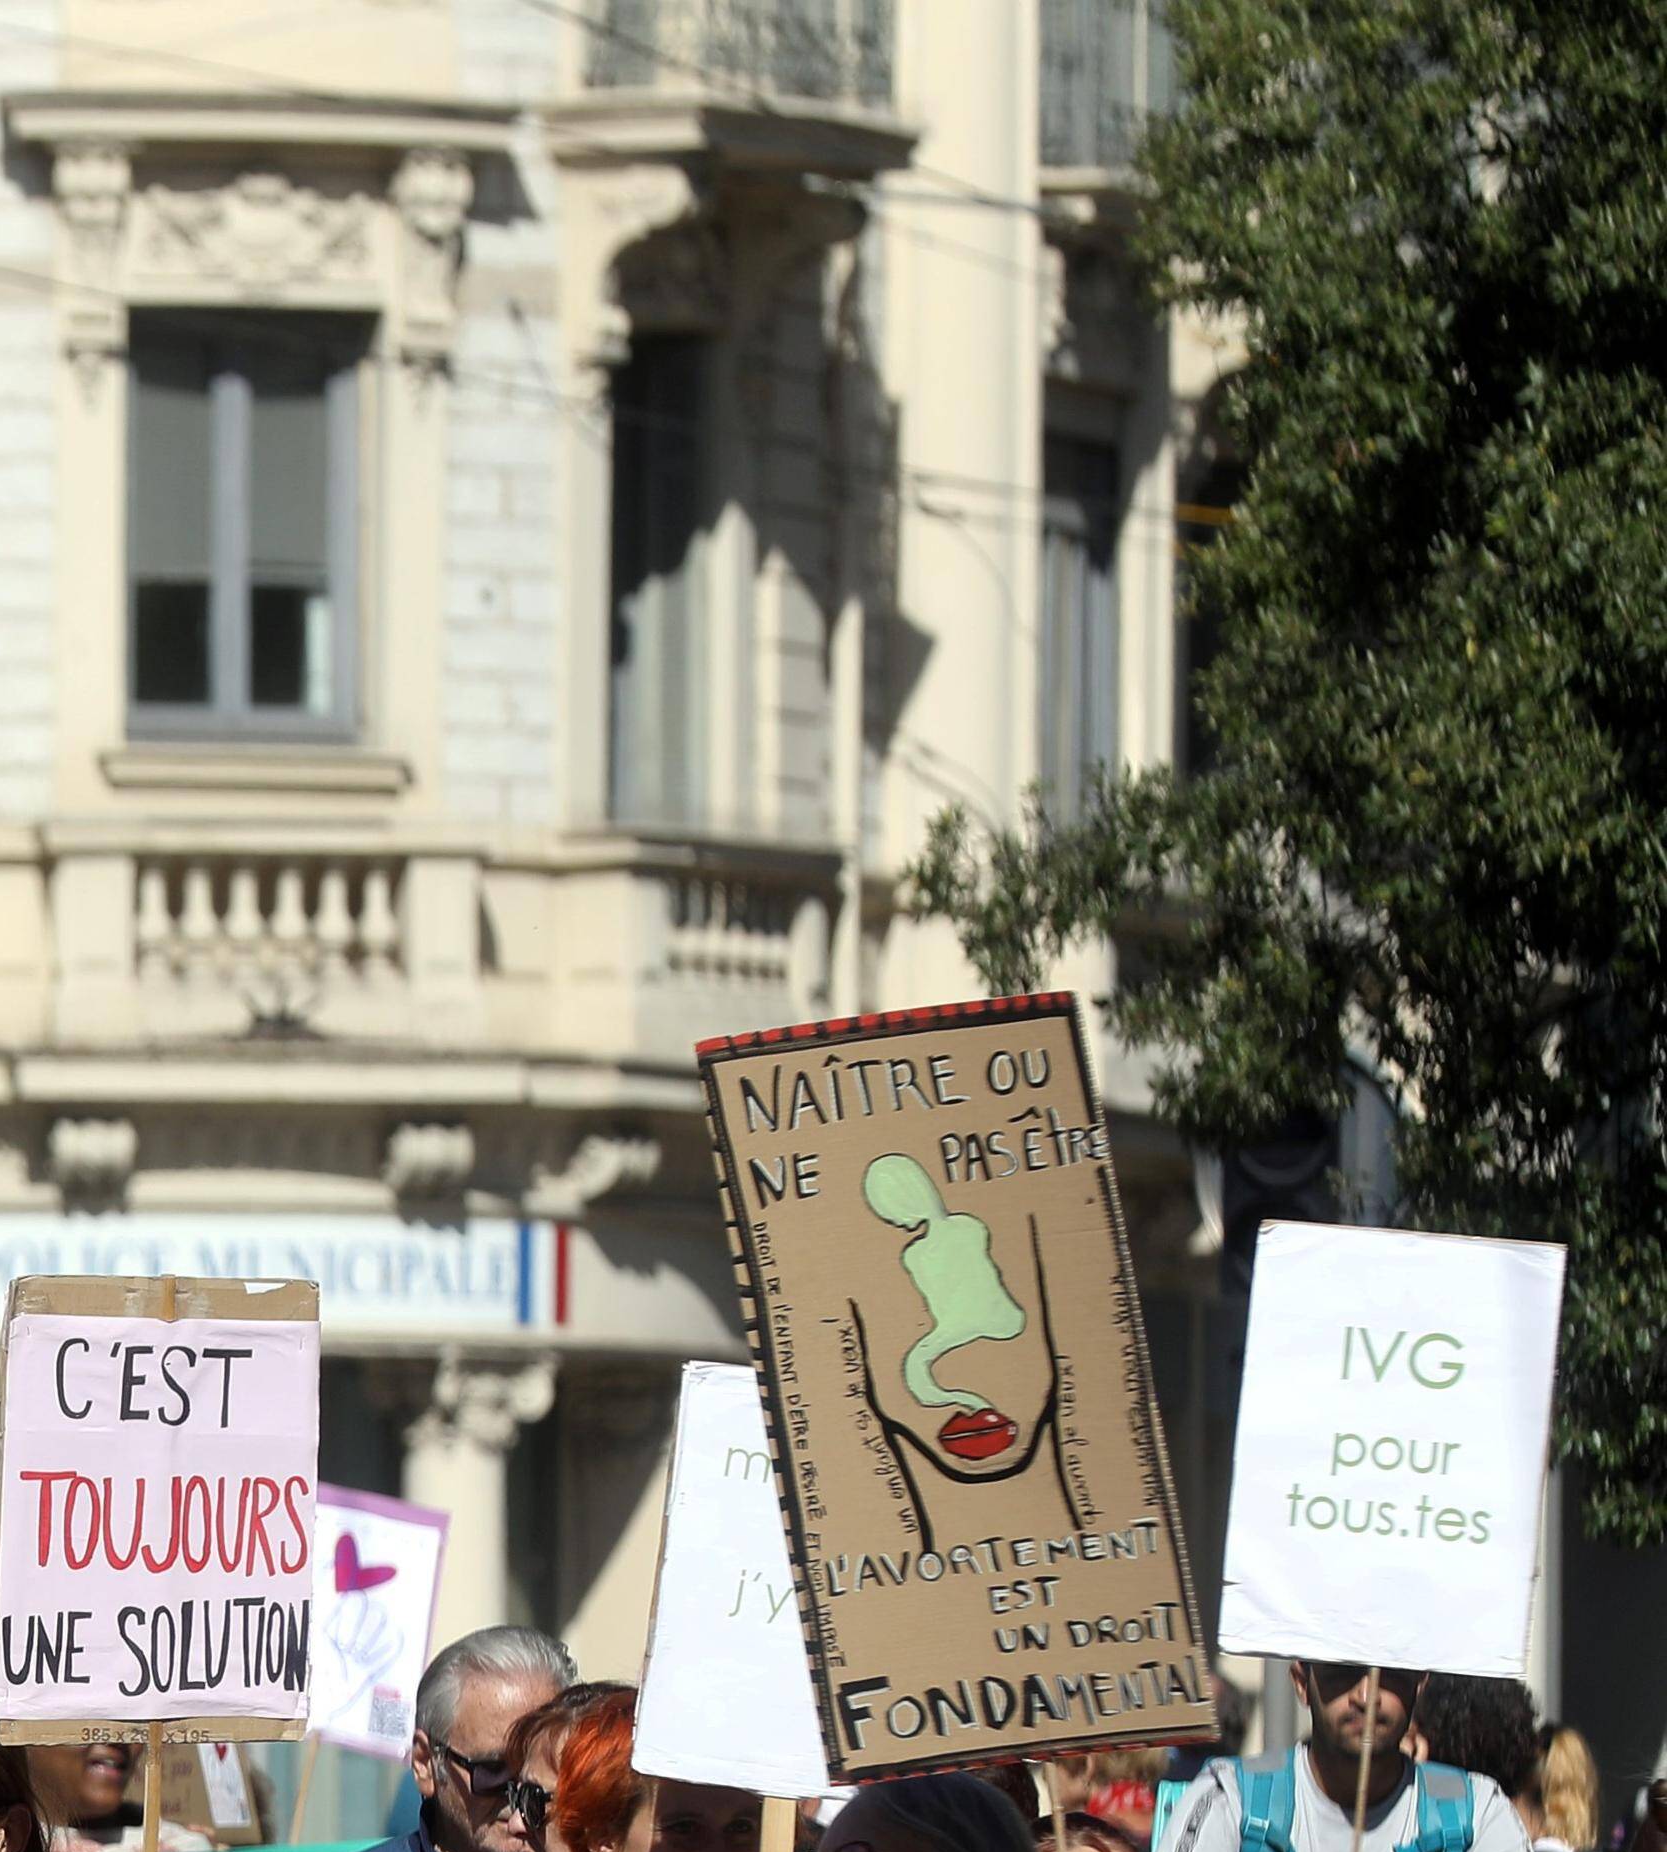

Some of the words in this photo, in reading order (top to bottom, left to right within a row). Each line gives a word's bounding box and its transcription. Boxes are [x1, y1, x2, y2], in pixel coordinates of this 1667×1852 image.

[739, 1054, 971, 1133] NAÎTRE
[986, 1049, 1051, 1095] OU
[748, 1152, 820, 1208] NE
[940, 1131, 1020, 1182] PAS
[54, 1338, 253, 1430] C'EST
[1341, 1326, 1465, 1389] IVG
[1331, 1432, 1461, 1476] pour
[20, 1470, 310, 1579] TOUJOURS
[1287, 1484, 1491, 1545] tous.tes
[827, 1517, 1161, 1596] L'AVORTEMENT
[987, 1575, 1061, 1613] EST
[3, 1610, 92, 1685] UNE
[117, 1596, 311, 1697] SOLUTION
[995, 1623, 1049, 1654] UN
[81, 1727, 111, 1742] 385
[117, 1731, 126, 1742] x
[167, 1731, 175, 1742] x
[837, 1654, 1212, 1750] FONDAMENTAL
